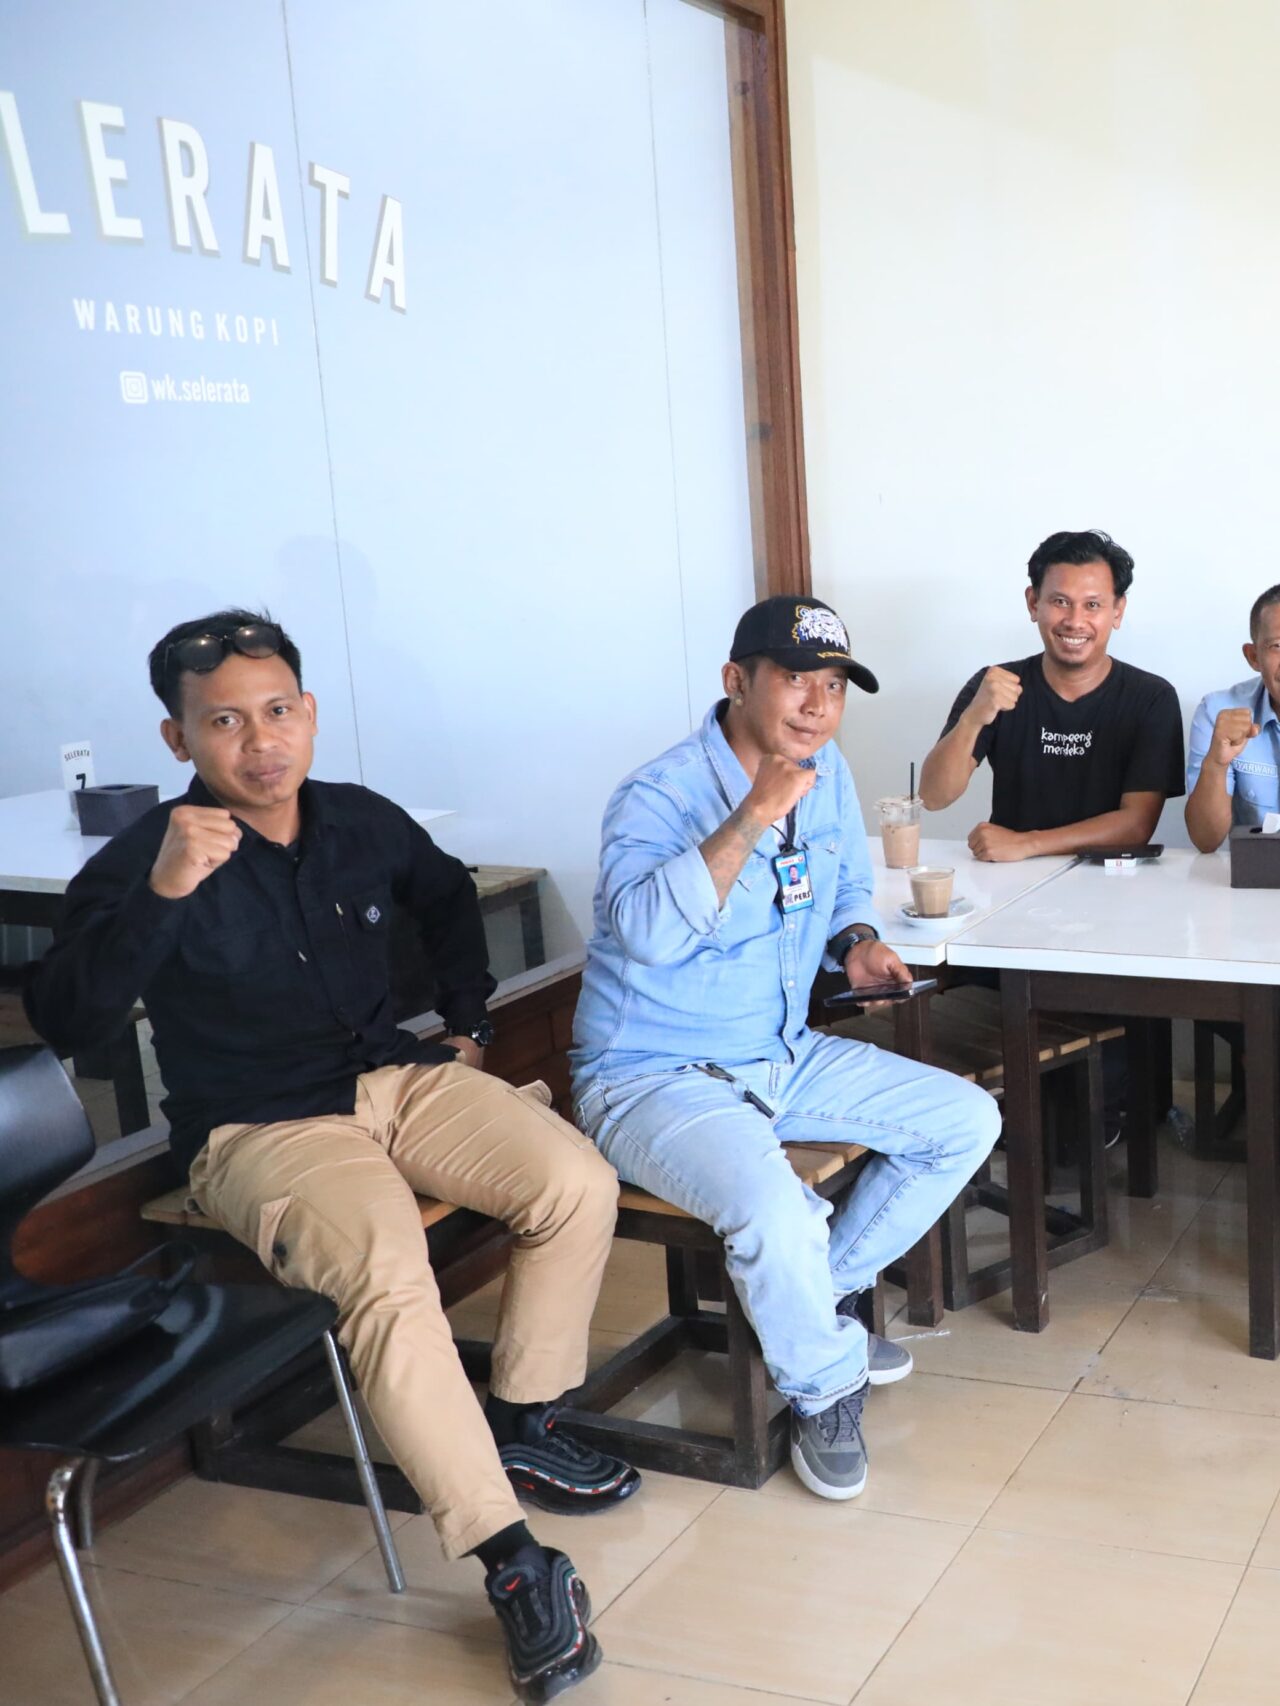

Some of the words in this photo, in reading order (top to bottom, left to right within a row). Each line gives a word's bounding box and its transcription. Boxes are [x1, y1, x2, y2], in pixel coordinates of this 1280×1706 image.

[0, 89, 406, 314] LERATA
[73, 298, 205, 340] WARUNG
[215, 313, 279, 346] KOPI
[151, 373, 250, 403] wk.selerata
[1041, 726, 1093, 748] kampoeng
[64, 749, 90, 762] SELERATA
[1043, 743, 1085, 757] merdeka
[75, 772, 87, 790] 7
